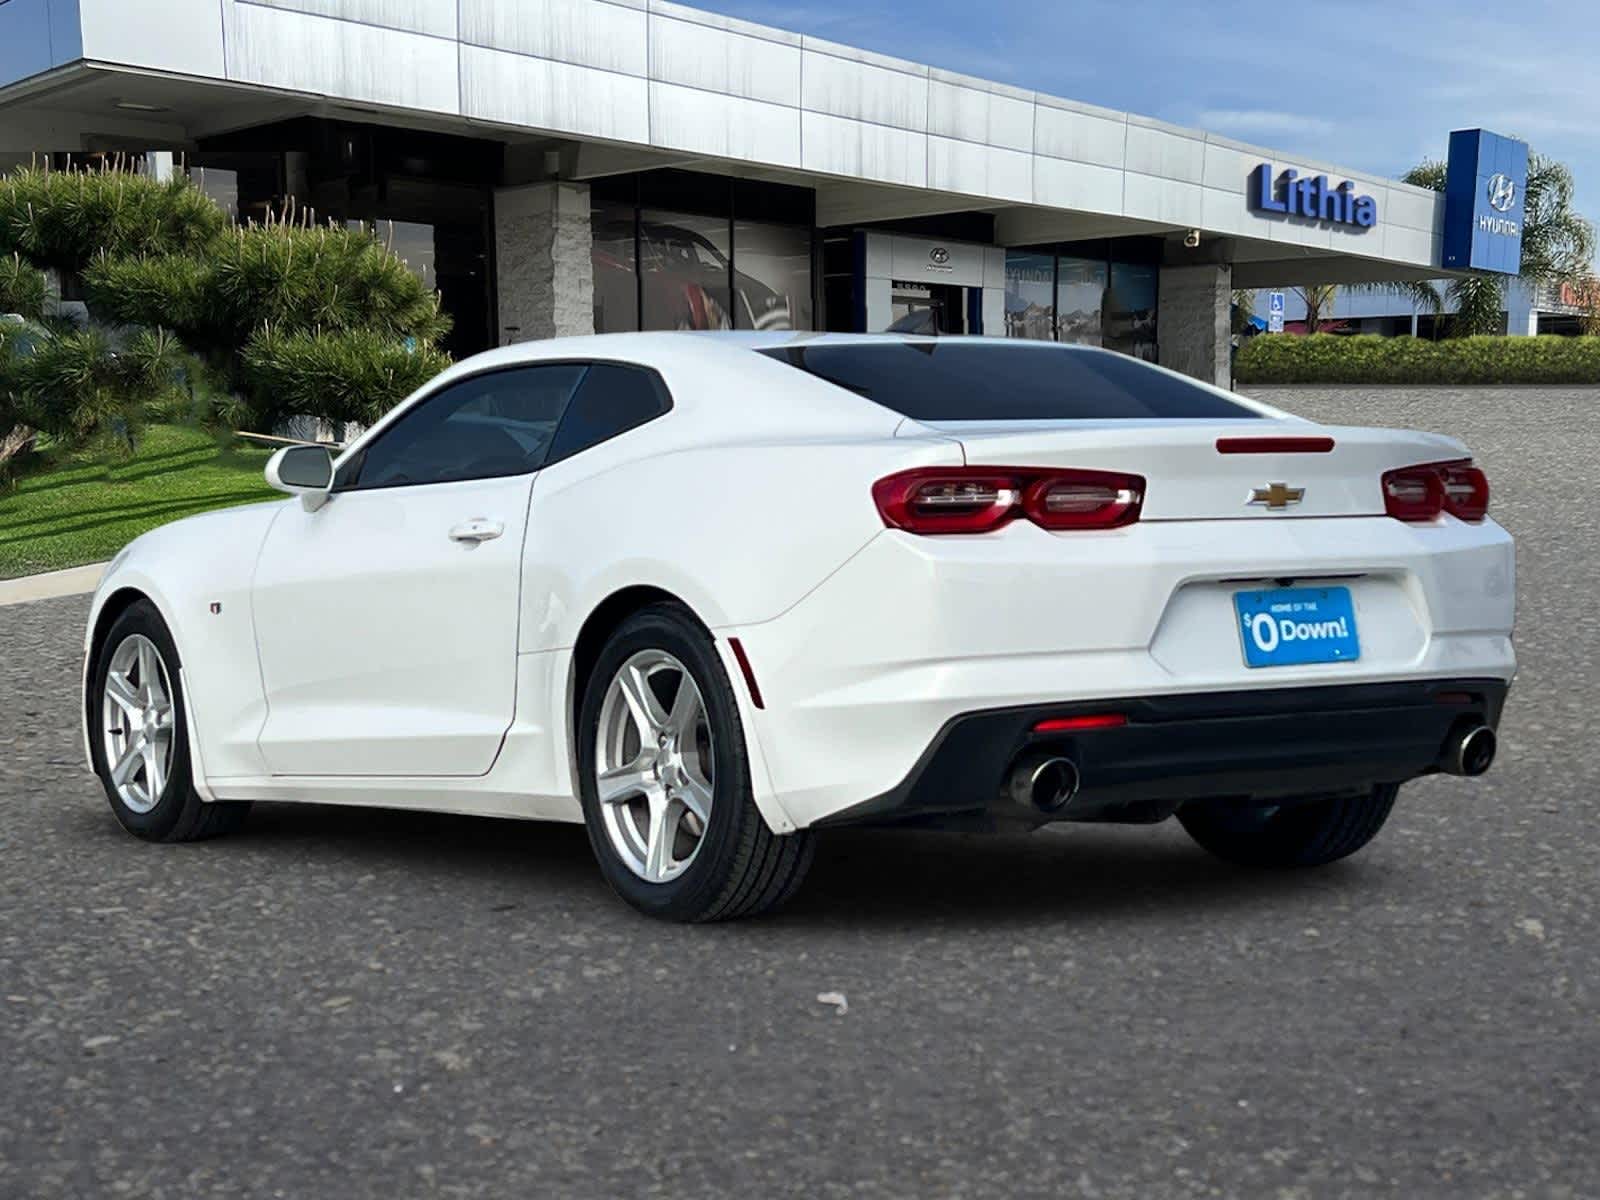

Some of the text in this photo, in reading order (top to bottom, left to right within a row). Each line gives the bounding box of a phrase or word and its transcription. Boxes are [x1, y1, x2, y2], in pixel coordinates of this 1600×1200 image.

[1250, 163, 1377, 228] Lithia
[1480, 215, 1521, 238] HYUNDAI
[1280, 616, 1349, 641] Down!
